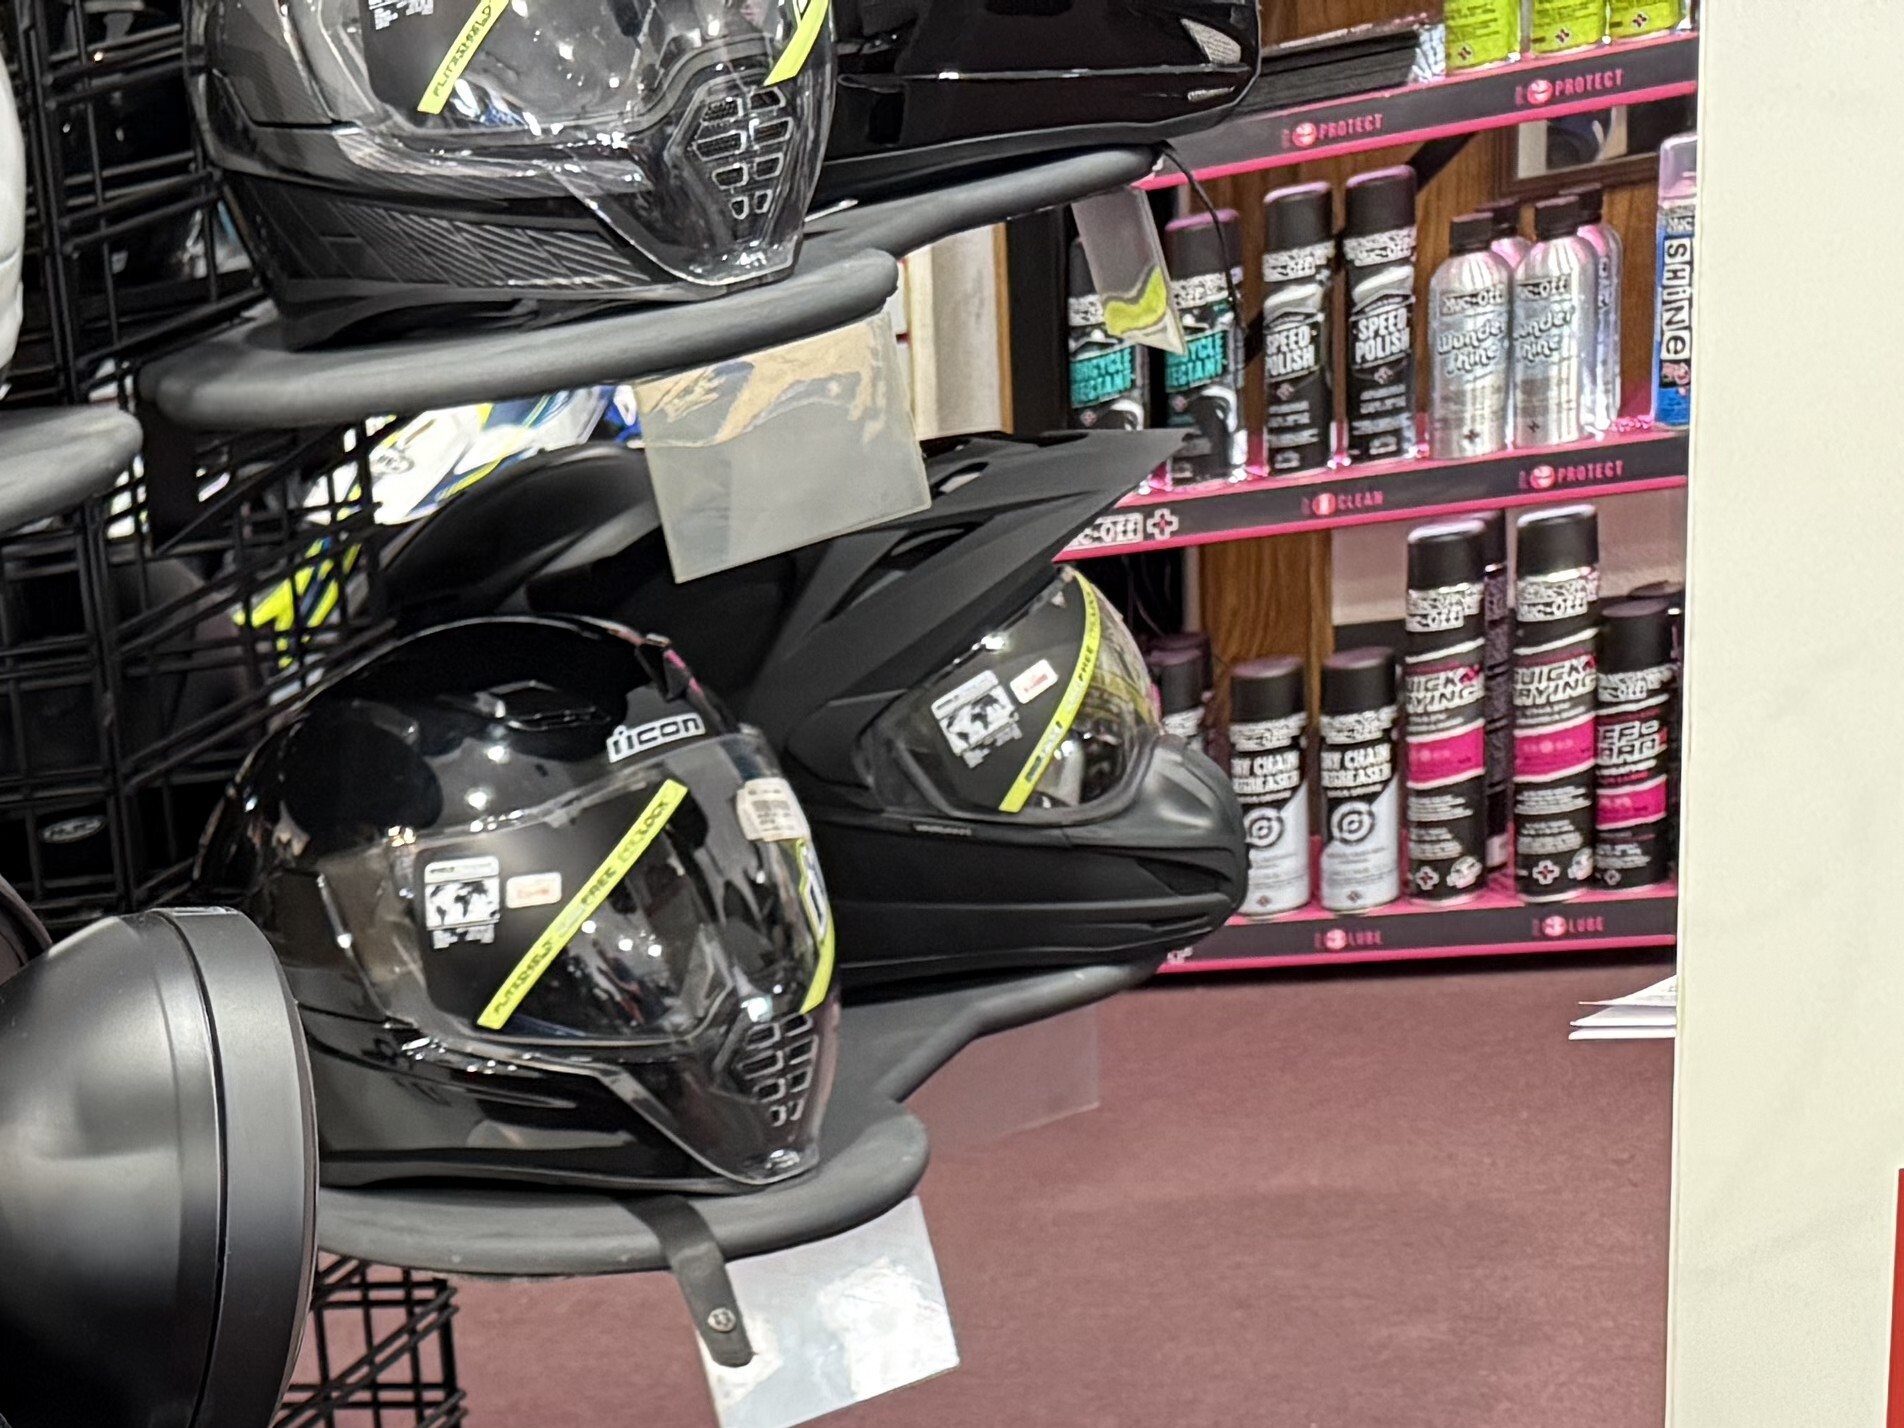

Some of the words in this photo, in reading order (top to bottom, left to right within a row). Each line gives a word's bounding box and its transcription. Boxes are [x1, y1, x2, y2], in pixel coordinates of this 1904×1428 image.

[1555, 71, 1623, 98] PROTECT
[1318, 113, 1383, 139] PROTECT
[1357, 310, 1408, 341] SPEED
[1355, 332, 1411, 364] POLISH
[1558, 460, 1624, 484] PROTECT
[1335, 489, 1385, 512] CLEAN
[1075, 515, 1142, 545] C-OFF
[1569, 915, 1604, 935] LUBE
